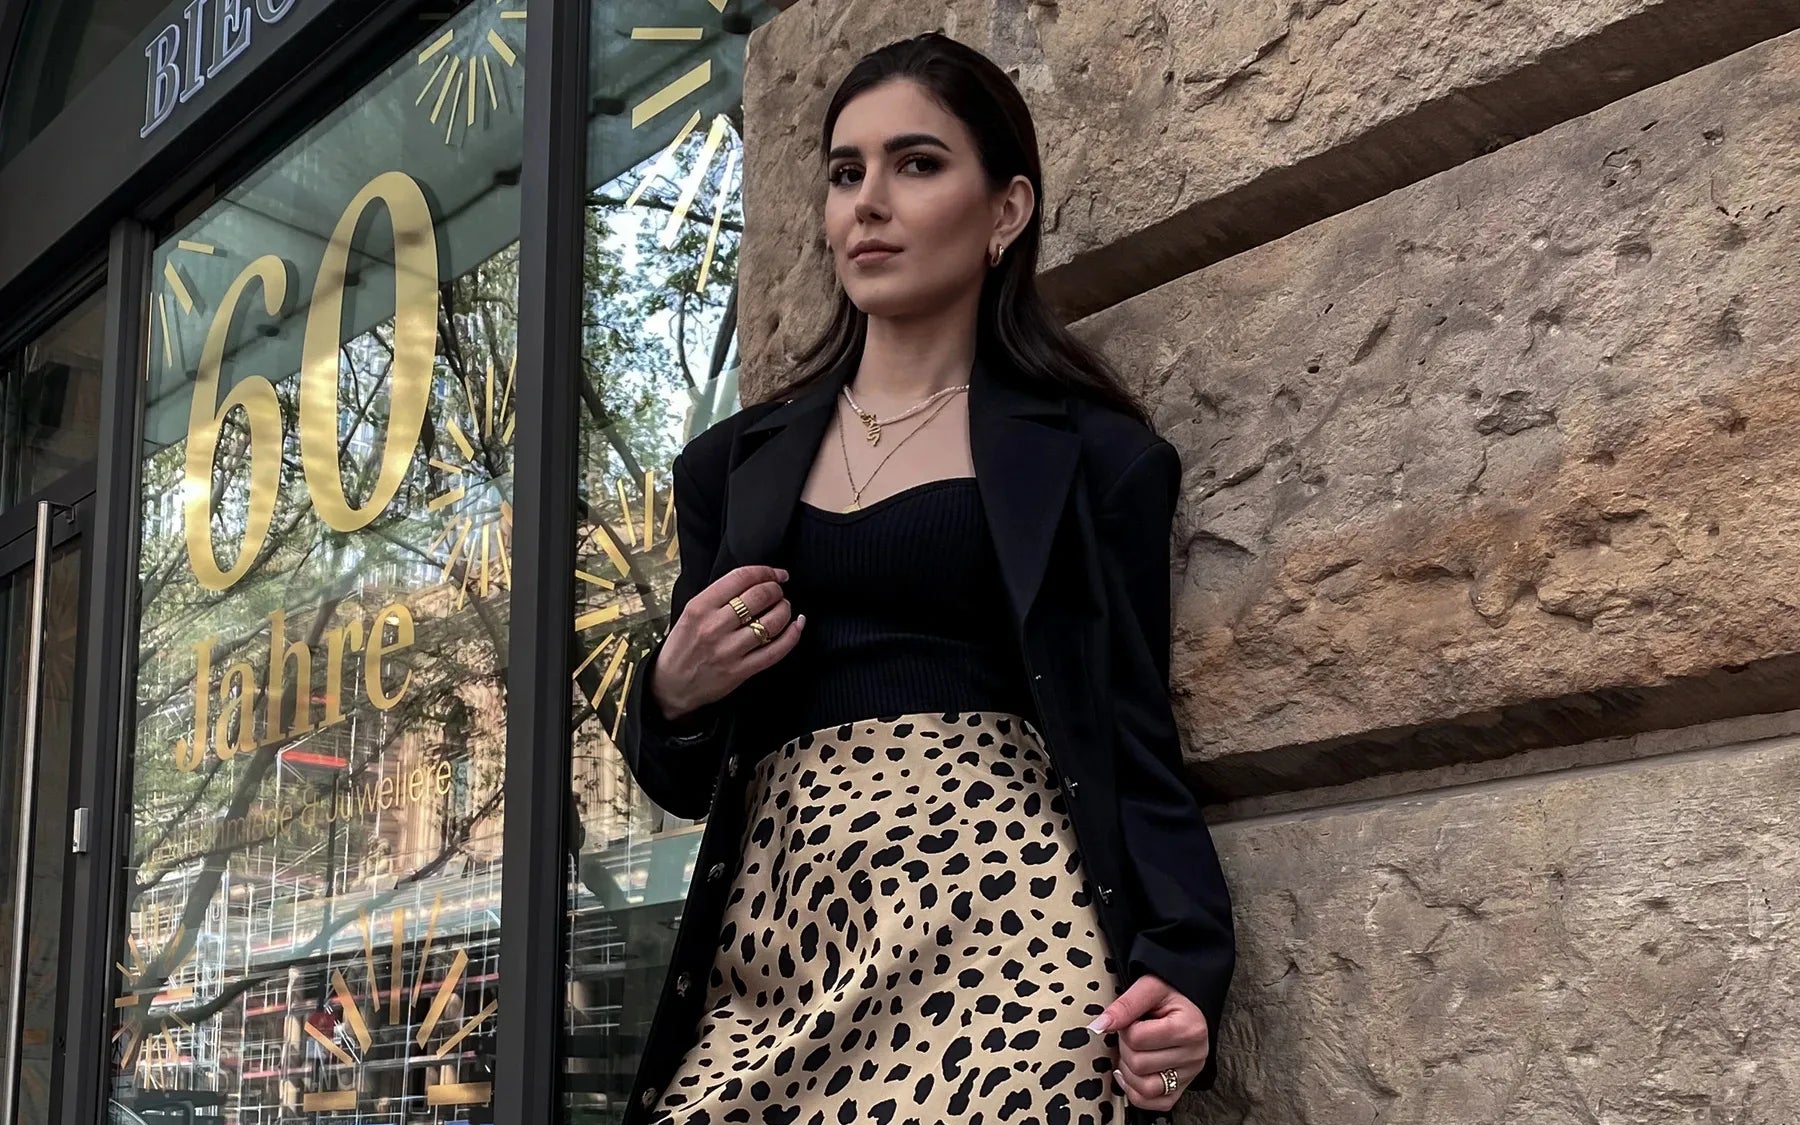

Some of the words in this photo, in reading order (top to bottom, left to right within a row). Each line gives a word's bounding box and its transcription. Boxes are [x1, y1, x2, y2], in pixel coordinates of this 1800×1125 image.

[184, 171, 438, 590] 60
[174, 602, 415, 773] Jahre
[326, 760, 452, 823] Juweliere
